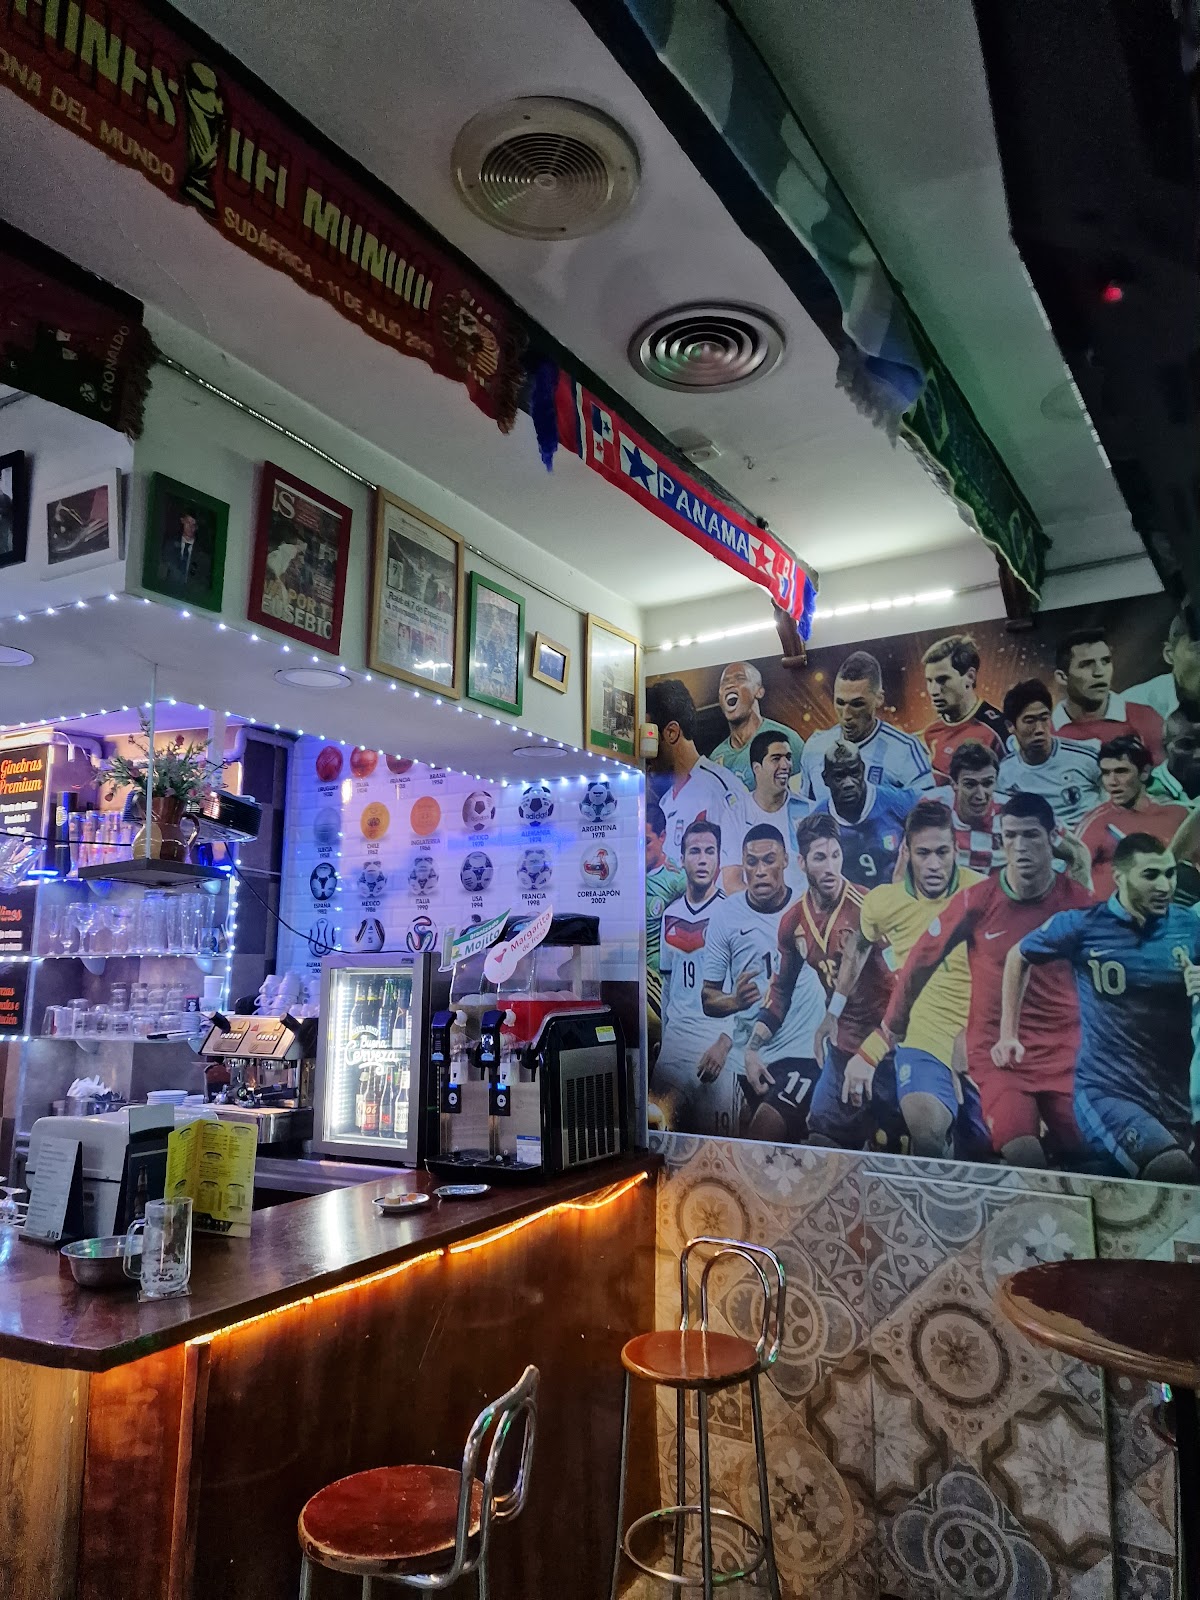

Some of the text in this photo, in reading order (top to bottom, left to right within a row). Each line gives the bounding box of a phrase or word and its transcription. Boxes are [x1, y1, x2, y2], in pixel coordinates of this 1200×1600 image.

[51, 86, 93, 133] DEL
[100, 119, 175, 185] MUNDO
[101, 325, 130, 395] RONALDO
[659, 471, 749, 558] PANAMA
[288, 588, 317, 615] POR
[261, 593, 333, 640] EUSEBIO
[0, 758, 42, 780] Ginebras
[0, 777, 42, 795] Premium
[525, 811, 548, 820] adidas
[581, 824, 617, 833] ARGENTINA
[410, 838, 441, 846] INGLATERRA
[858, 853, 878, 877] 9
[577, 888, 621, 898] COREA-JAPÓN
[464, 929, 500, 956] Mojito
[469, 920, 499, 940] Granizado
[510, 912, 551, 952] Margarita
[522, 928, 546, 952] de fresa
[683, 960, 696, 989] 19
[1087, 959, 1127, 996] 10
[345, 1040, 402, 1066] Cerveza
[360, 1034, 388, 1050] Buena
[784, 1071, 812, 1104] 11
[714, 1110, 730, 1135] 19
